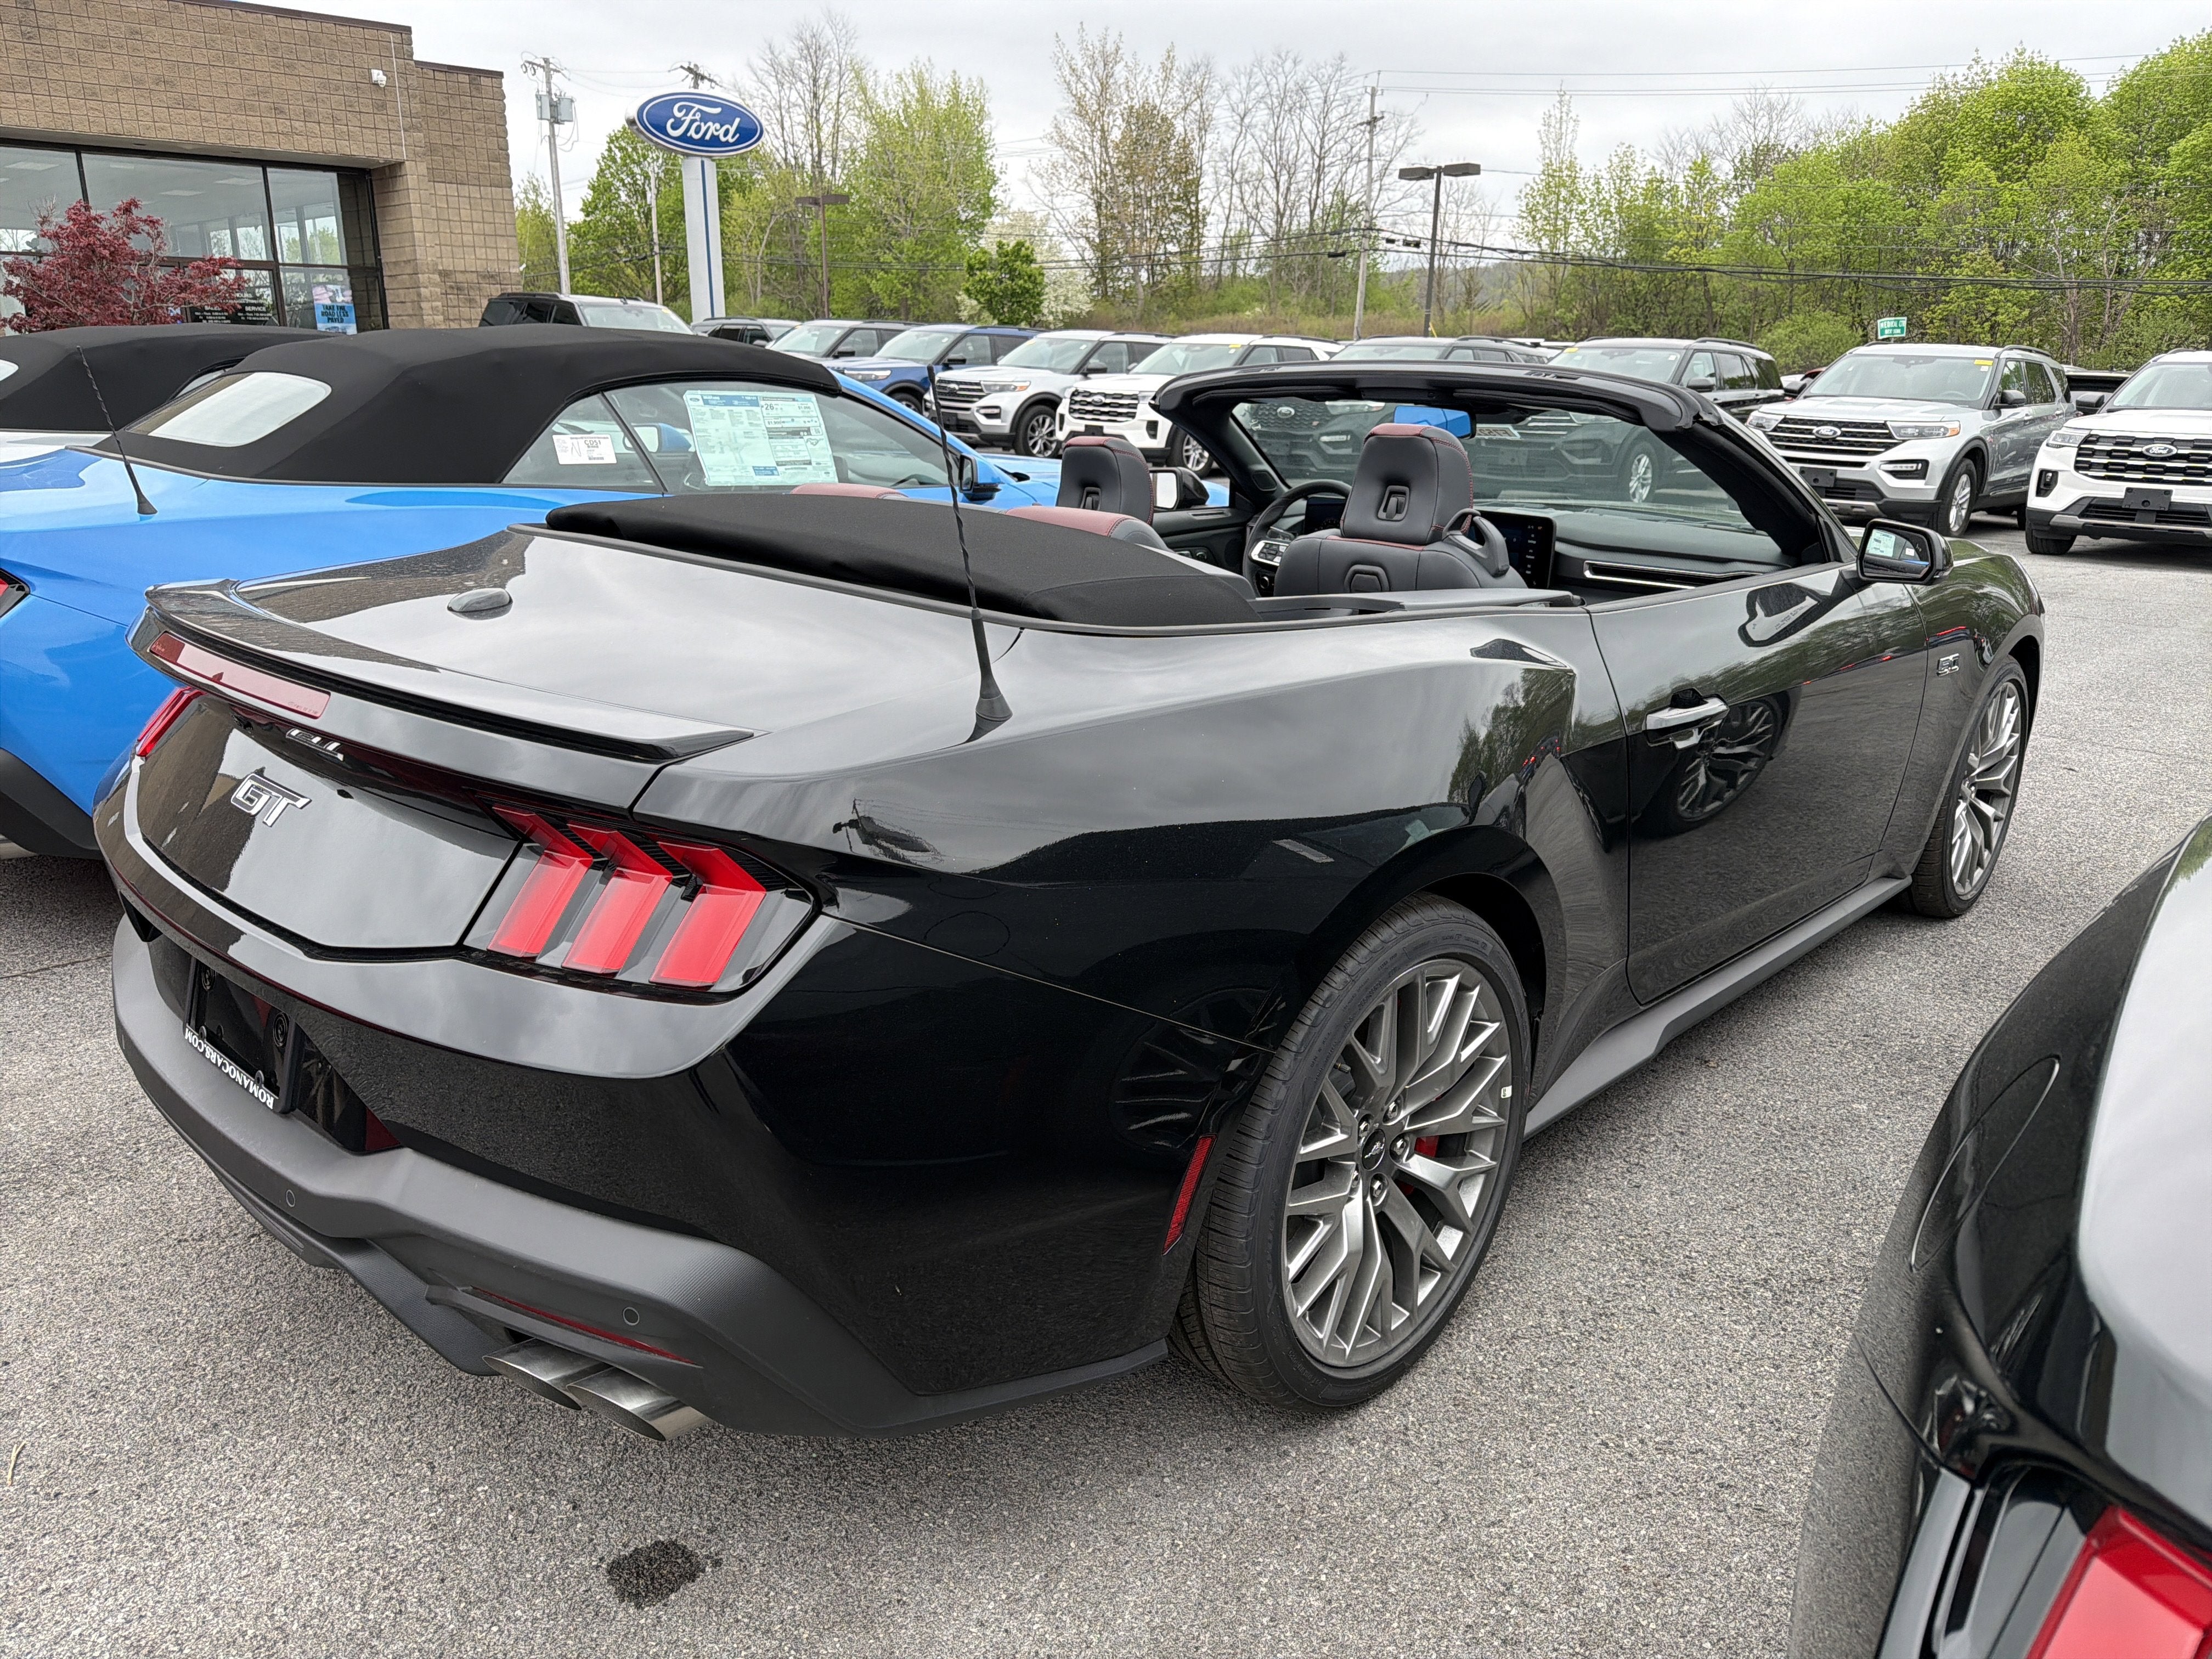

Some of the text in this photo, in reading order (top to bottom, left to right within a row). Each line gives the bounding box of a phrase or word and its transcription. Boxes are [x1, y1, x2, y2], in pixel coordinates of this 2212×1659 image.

[666, 101, 741, 143] Ford
[1880, 320, 1898, 329] MEDICAL
[231, 774, 312, 827] GT
[184, 1028, 274, 1109] ROMANOCARS.COM
